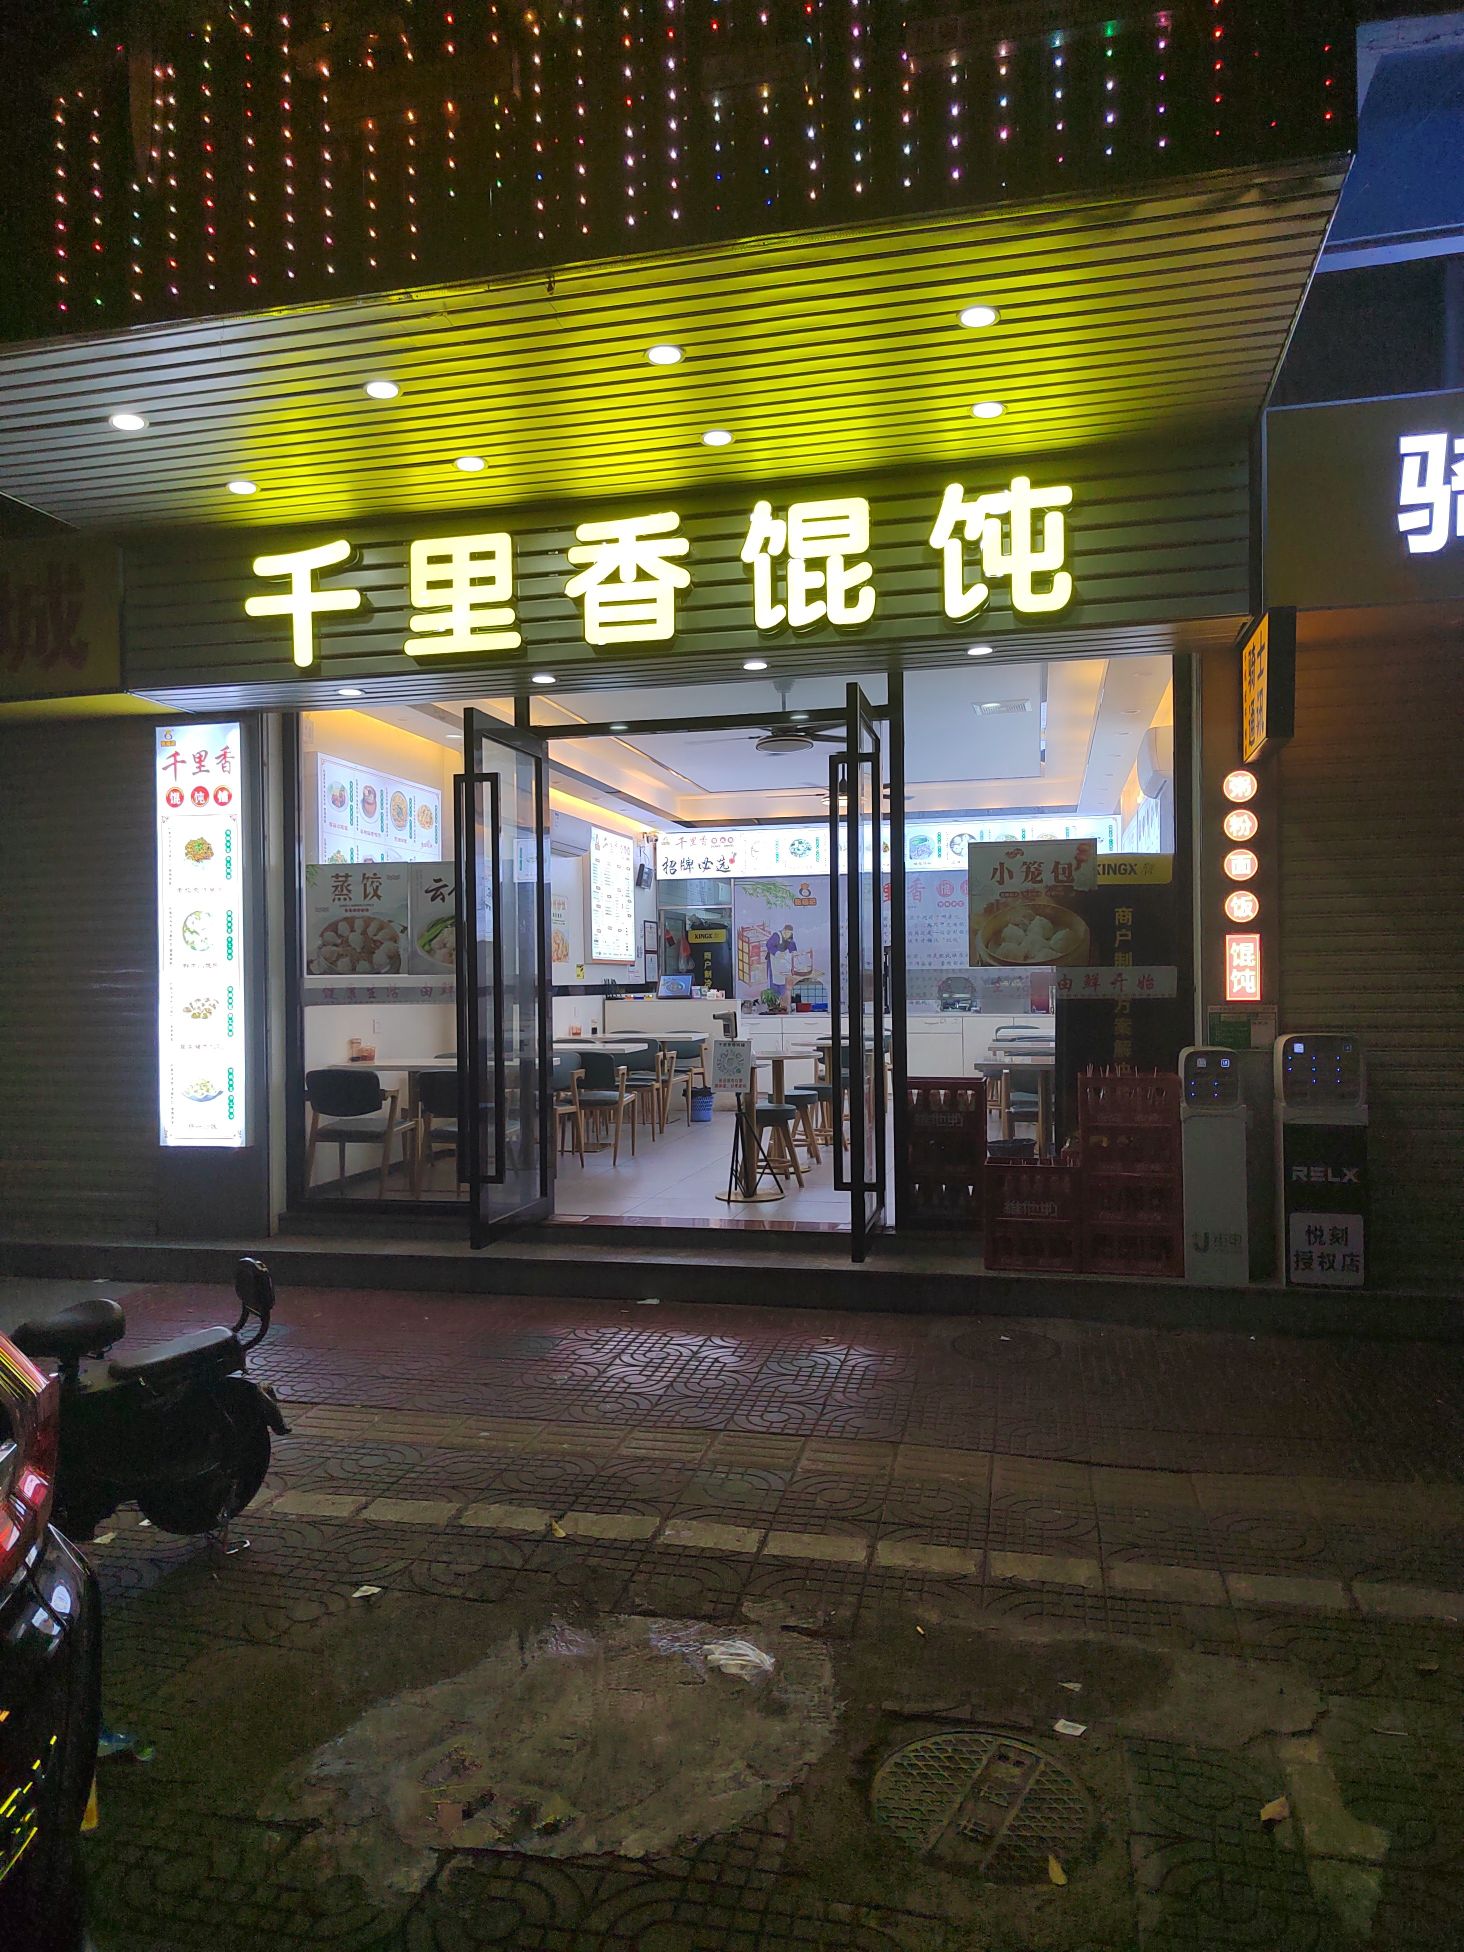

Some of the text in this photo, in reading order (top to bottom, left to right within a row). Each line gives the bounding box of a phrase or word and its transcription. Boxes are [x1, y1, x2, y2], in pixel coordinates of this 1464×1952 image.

[244, 475, 1074, 669] 千里香馄饨
[162, 745, 235, 782] 千里香
[675, 835, 708, 849] 千里香
[661, 854, 731, 875] 招牌必选
[991, 861, 1075, 886] 小笼包
[331, 872, 382, 902] 蒸饺
[424, 877, 456, 903] 云
[1230, 941, 1257, 994] 馄饨
[1057, 972, 1155, 993] 由鲜开始
[1291, 1166, 1360, 1184] RELX
[1305, 1224, 1349, 1247] 悦刻
[1293, 1250, 1361, 1274] 授权店
